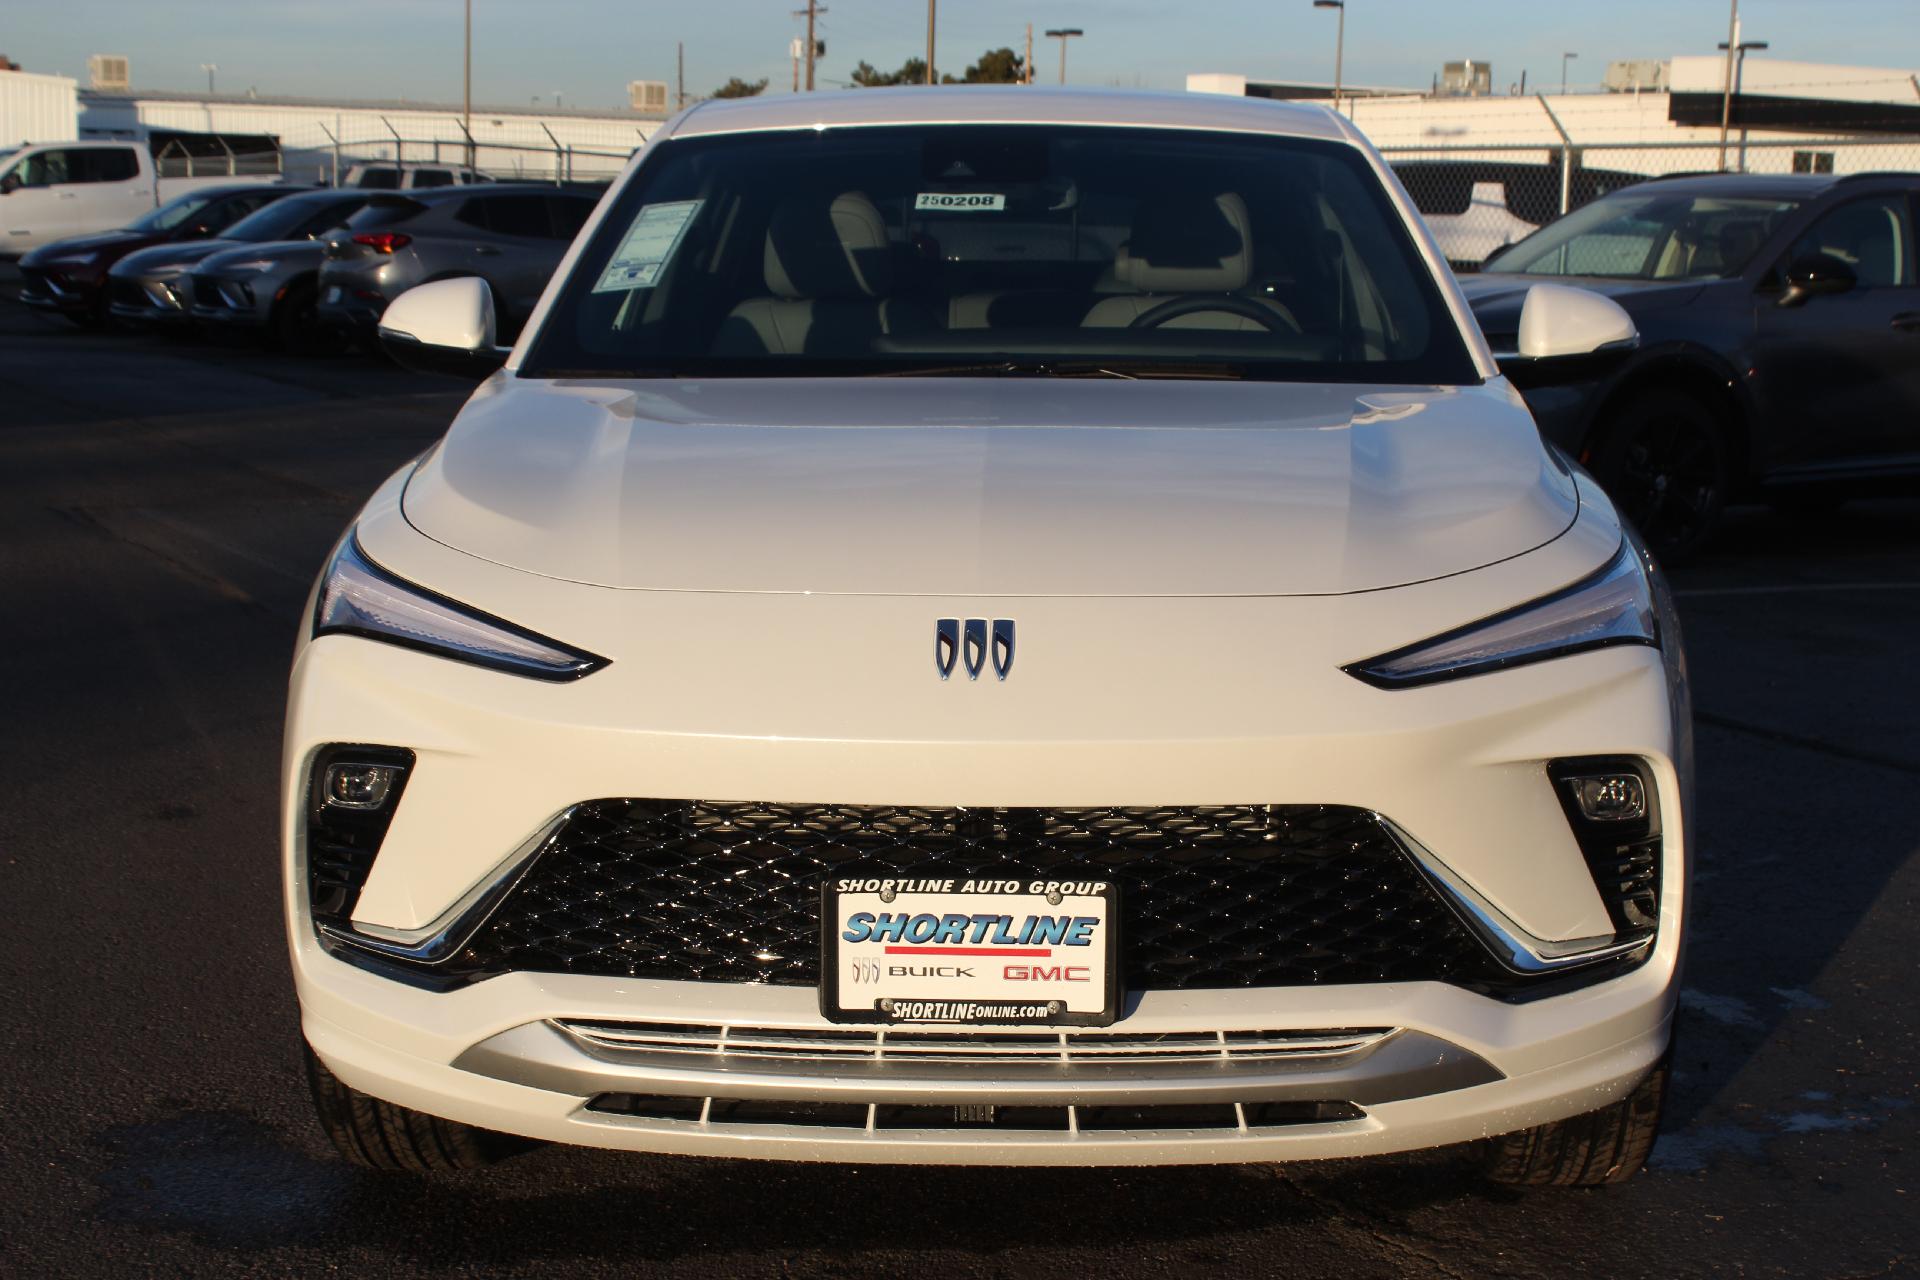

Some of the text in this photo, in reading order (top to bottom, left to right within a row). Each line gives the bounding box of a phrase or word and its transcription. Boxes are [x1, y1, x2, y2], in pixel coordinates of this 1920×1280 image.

[837, 879, 1106, 896] SHORTLINE AUTO GROUP
[842, 912, 1100, 946] SHORTLINE
[888, 964, 1091, 982] BUICK GMC
